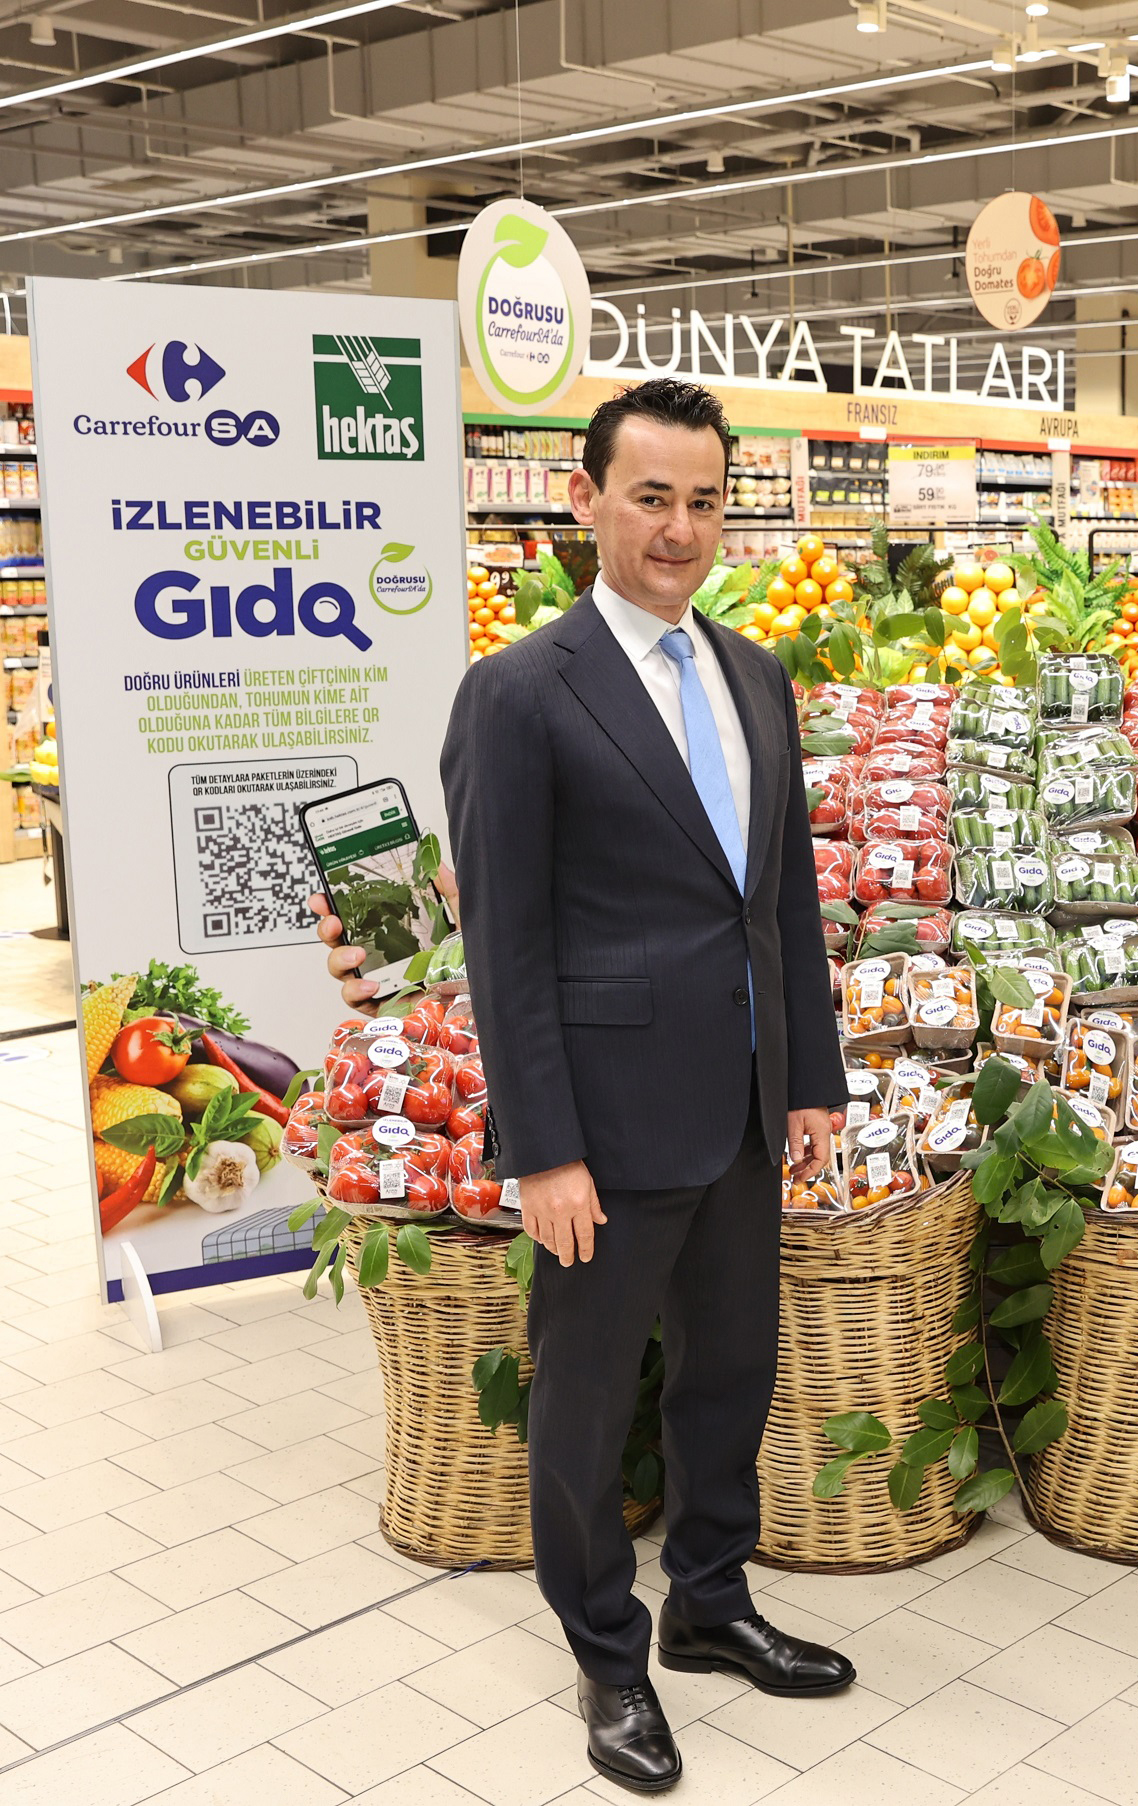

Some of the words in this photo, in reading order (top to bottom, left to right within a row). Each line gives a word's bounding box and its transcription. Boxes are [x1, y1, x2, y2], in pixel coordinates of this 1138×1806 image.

[975, 278, 1014, 291] Domates
[488, 296, 564, 324] DOĞRUSU
[840, 325, 1065, 412] TATLARI
[847, 402, 897, 425] FRANSIZ
[322, 404, 420, 459] hektaş
[1040, 417, 1079, 439] AVRUPA
[376, 574, 426, 585] DOĞRUSU
[124, 672, 170, 691] DOĞRU
[174, 669, 240, 690] ÜRÜNLERİ
[244, 669, 295, 687] ÜRETEN
[299, 665, 361, 685] ÇİFTÇİNİN
[364, 665, 388, 682] KİM
[147, 692, 242, 711] OLDUĞUNDAN,
[246, 691, 310, 707] TOHUMUN
[313, 688, 346, 705] KİME
[350, 687, 369, 703] AİT
[138, 712, 211, 733] OLDUĞUNA
[215, 713, 260, 730] KADAR
[263, 709, 292, 727] TÜM
[295, 706, 359, 725] BİLGİLERE
[363, 707, 380, 724] QR
[147, 737, 184, 753] KODU
[188, 733, 258, 751] OKUTARAK
[262, 727, 373, 750] ULAŞABİLİRSİNİZ.
[191, 774, 206, 785] TÜM
[208, 773, 250, 784] DETAYLARA
[252, 769, 294, 782] PAKETLERİN
[296, 767, 337, 779] ÜZERİNDEKİ
[193, 786, 203, 796] QR
[204, 784, 235, 795] KODLARI
[237, 782, 275, 793] OKUTARAK
[276, 778, 337, 792] ULAŞABİLİRSİNİZ.
[1048, 787, 1070, 797] Gıda
[1018, 867, 1043, 875] Gıda
[374, 1046, 404, 1057] Gıda
[1087, 1038, 1111, 1056] Gıda
[379, 1125, 410, 1137] Gıda
